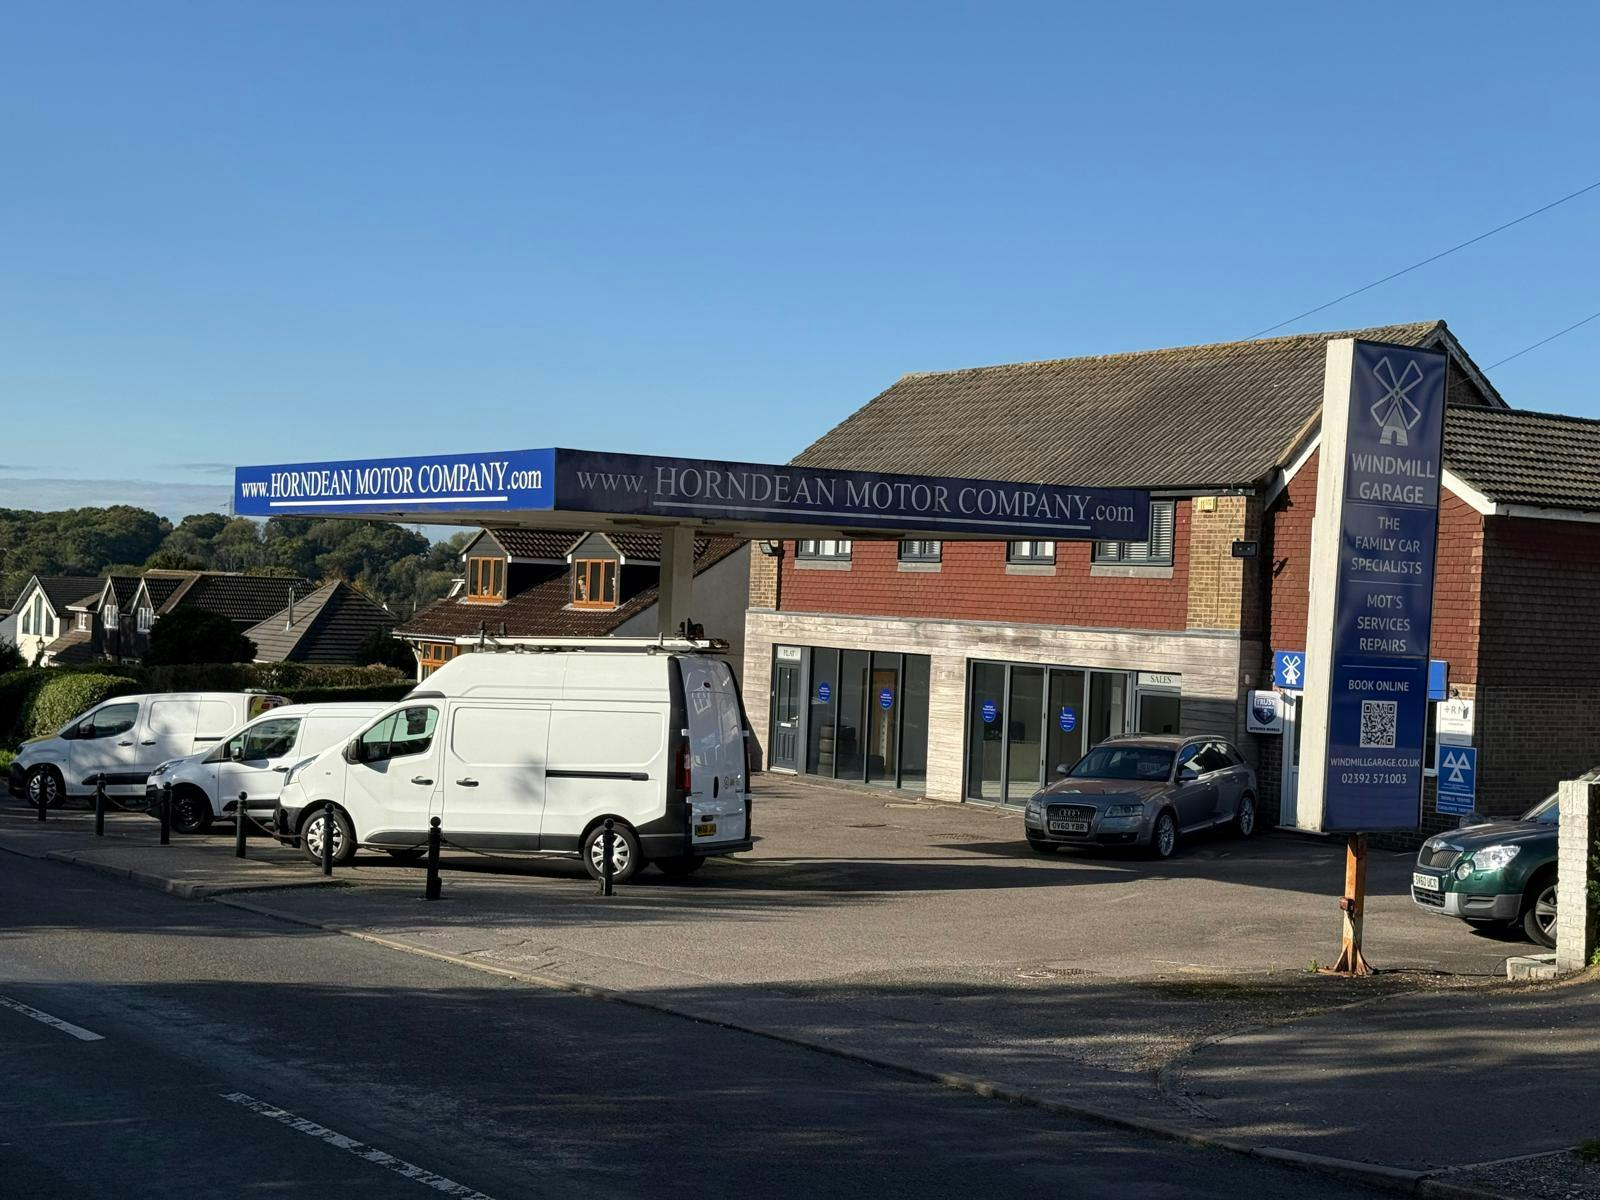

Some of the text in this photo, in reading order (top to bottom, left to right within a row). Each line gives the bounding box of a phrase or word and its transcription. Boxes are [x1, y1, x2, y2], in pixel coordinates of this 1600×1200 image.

[1352, 453, 1436, 478] WINDMILL
[355, 465, 414, 496] MOTOR
[418, 461, 542, 493] COMPANY.com
[845, 479, 952, 513] MOTOR
[1359, 481, 1424, 504] GARAGE
[1377, 516, 1400, 531] THE
[1355, 535, 1420, 553] FAMILY CAR
[1351, 557, 1422, 575] SPECIALISTS
[1367, 594, 1403, 609] MOT'S
[1357, 616, 1410, 631] SERVICES
[1359, 637, 1406, 652] REPAIRS
[1150, 675, 1172, 684] SALES
[1348, 679, 1409, 692] BOOK ONLINE
[1330, 757, 1420, 768] WINDMILLGARAGE.CO.UK
[1341, 773, 1407, 784] 02392 571003
